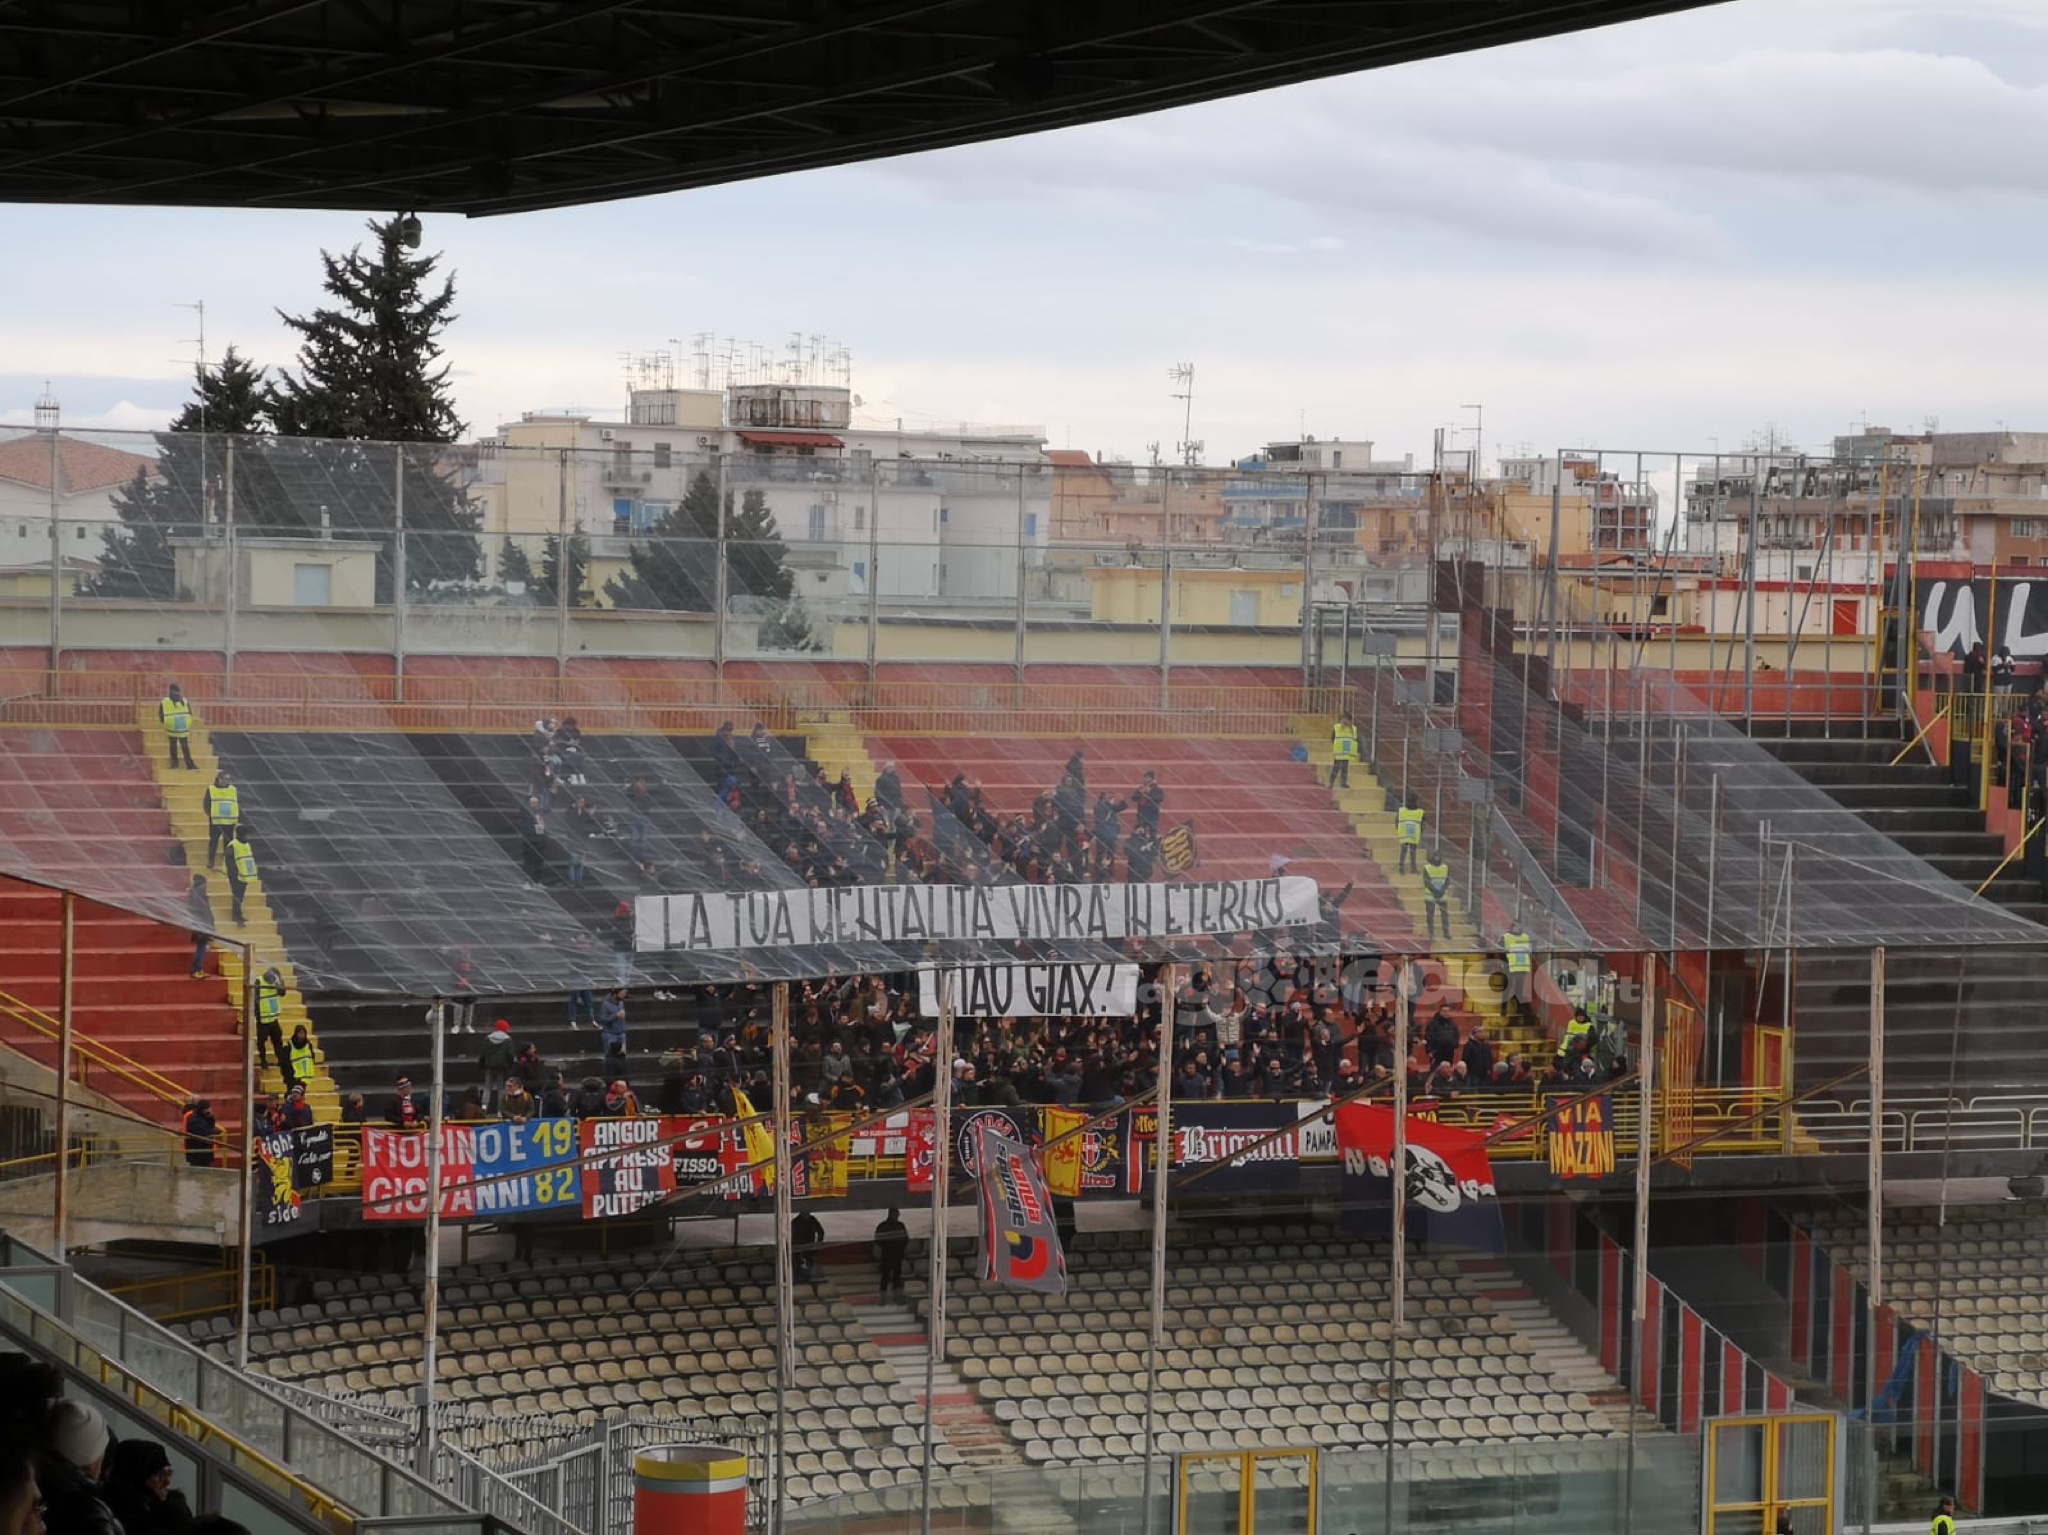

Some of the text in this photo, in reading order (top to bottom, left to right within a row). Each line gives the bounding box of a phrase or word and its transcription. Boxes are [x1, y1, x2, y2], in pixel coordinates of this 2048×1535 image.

[663, 892, 713, 949] LA
[725, 889, 795, 946] TUA
[1125, 884, 1150, 937] IN
[1025, 961, 1116, 1015] GIAX!
[1558, 1102, 1602, 1124] VIA
[368, 1128, 501, 1168] FIORINO
[509, 1125, 527, 1162] E
[532, 1118, 571, 1157] 19
[1549, 1130, 1615, 1174] MAZZINI
[535, 1167, 575, 1204] 82
[615, 1167, 643, 1192] AU
[672, 1158, 718, 1174] FISSO
